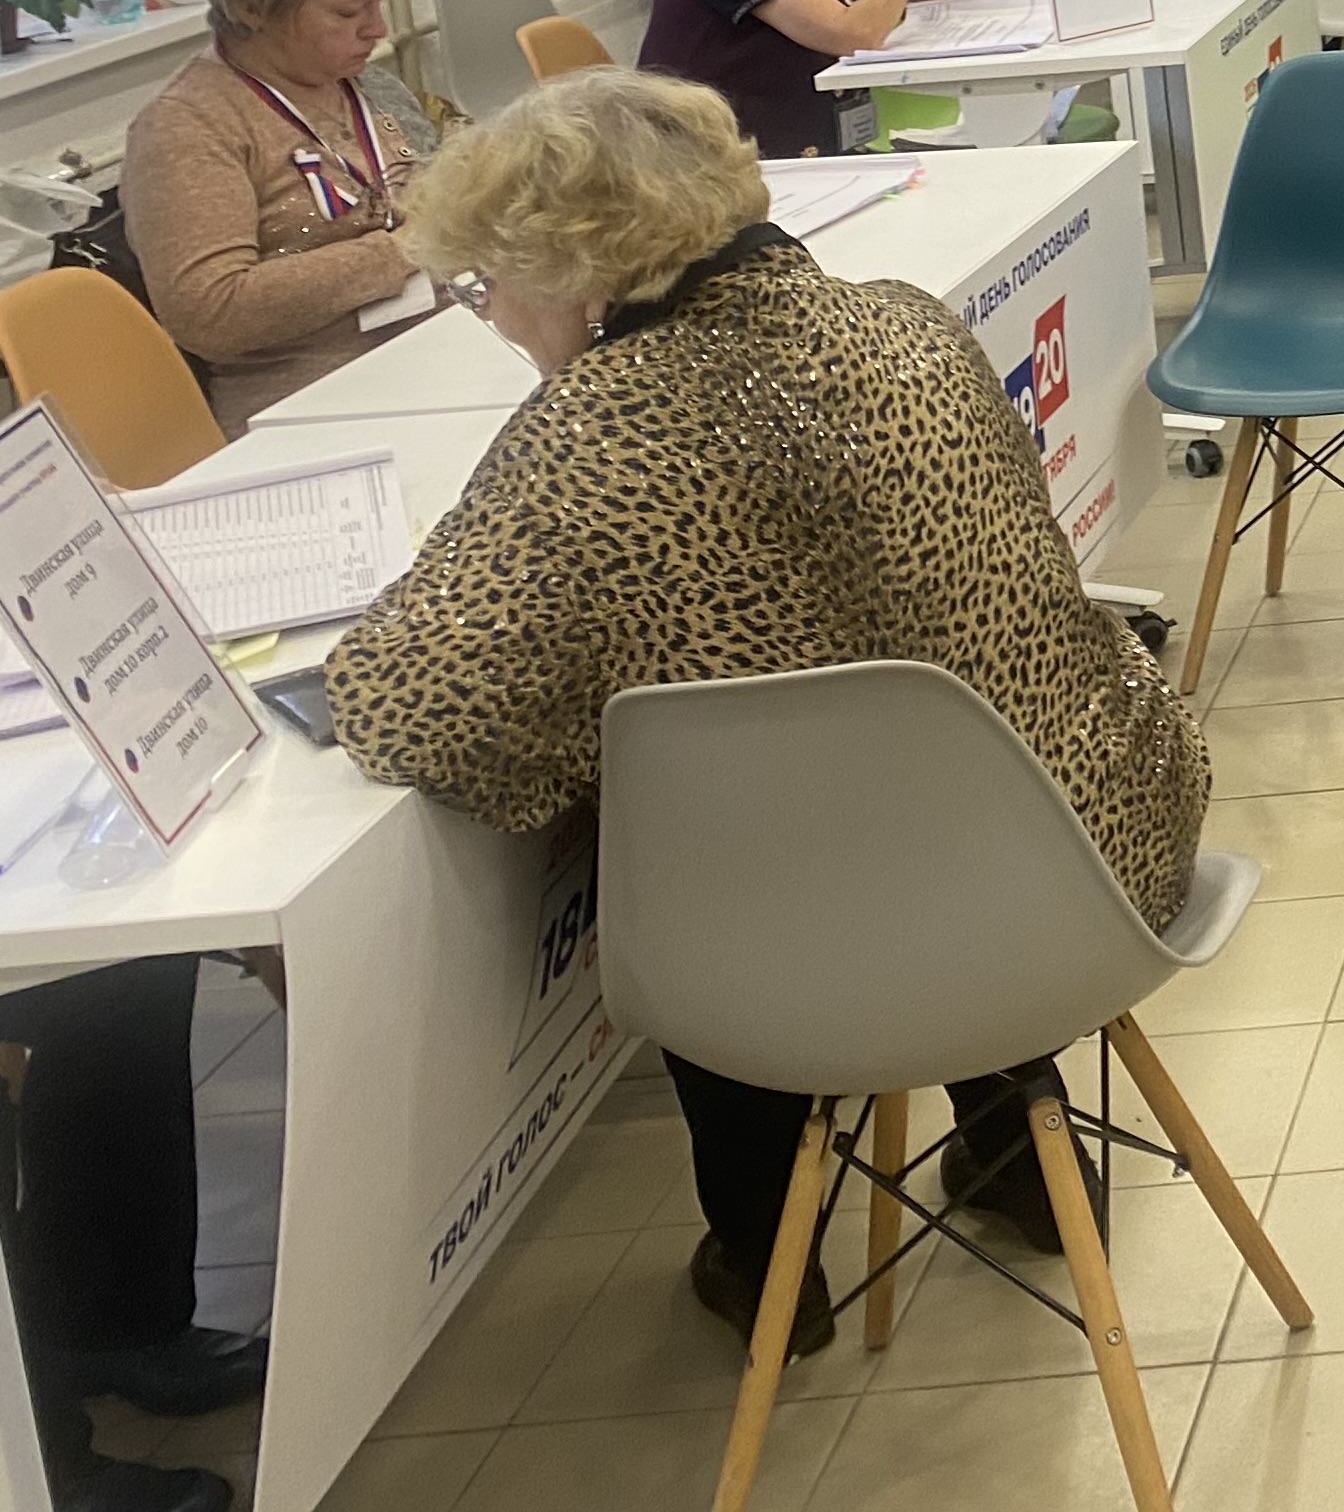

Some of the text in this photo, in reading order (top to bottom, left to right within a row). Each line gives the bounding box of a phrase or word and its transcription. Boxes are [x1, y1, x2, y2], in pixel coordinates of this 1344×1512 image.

[980, 276, 1011, 325] ДЕНЬ
[1012, 208, 1091, 292] ГОЛОСОВАНИЯ
[1036, 327, 1064, 400] 20
[539, 890, 583, 1001] 18
[428, 1161, 493, 1285] ТВОЙ
[496, 1072, 568, 1194] ГОЛОС
